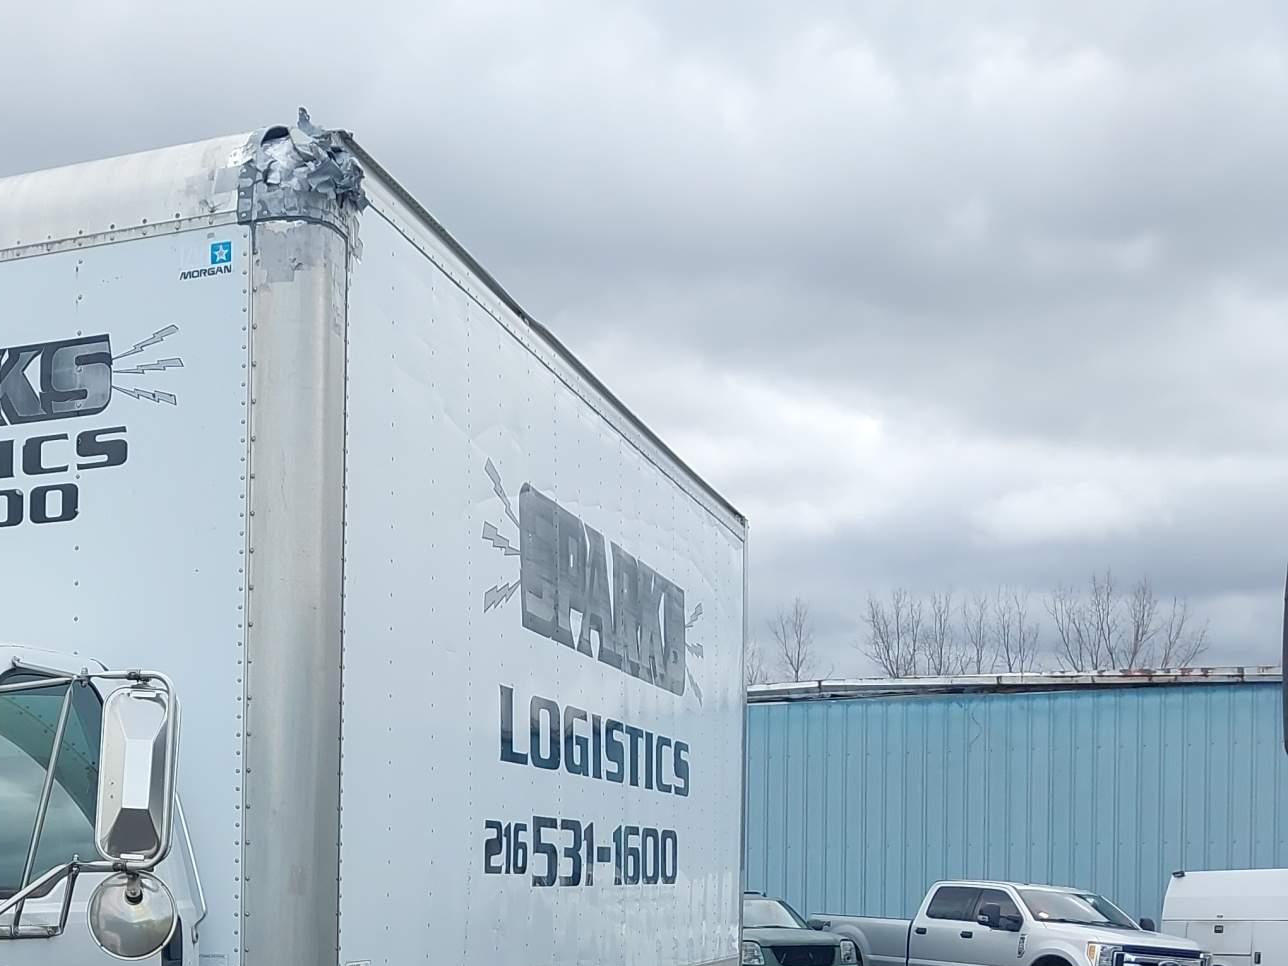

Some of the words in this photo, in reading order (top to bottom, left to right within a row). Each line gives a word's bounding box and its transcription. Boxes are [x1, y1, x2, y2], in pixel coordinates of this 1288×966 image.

[179, 264, 232, 281] MORGAN
[518, 481, 686, 697] SPARKS
[498, 683, 690, 798] LOGISTICS
[484, 819, 528, 876] 216
[530, 815, 679, 889] 531-1600
